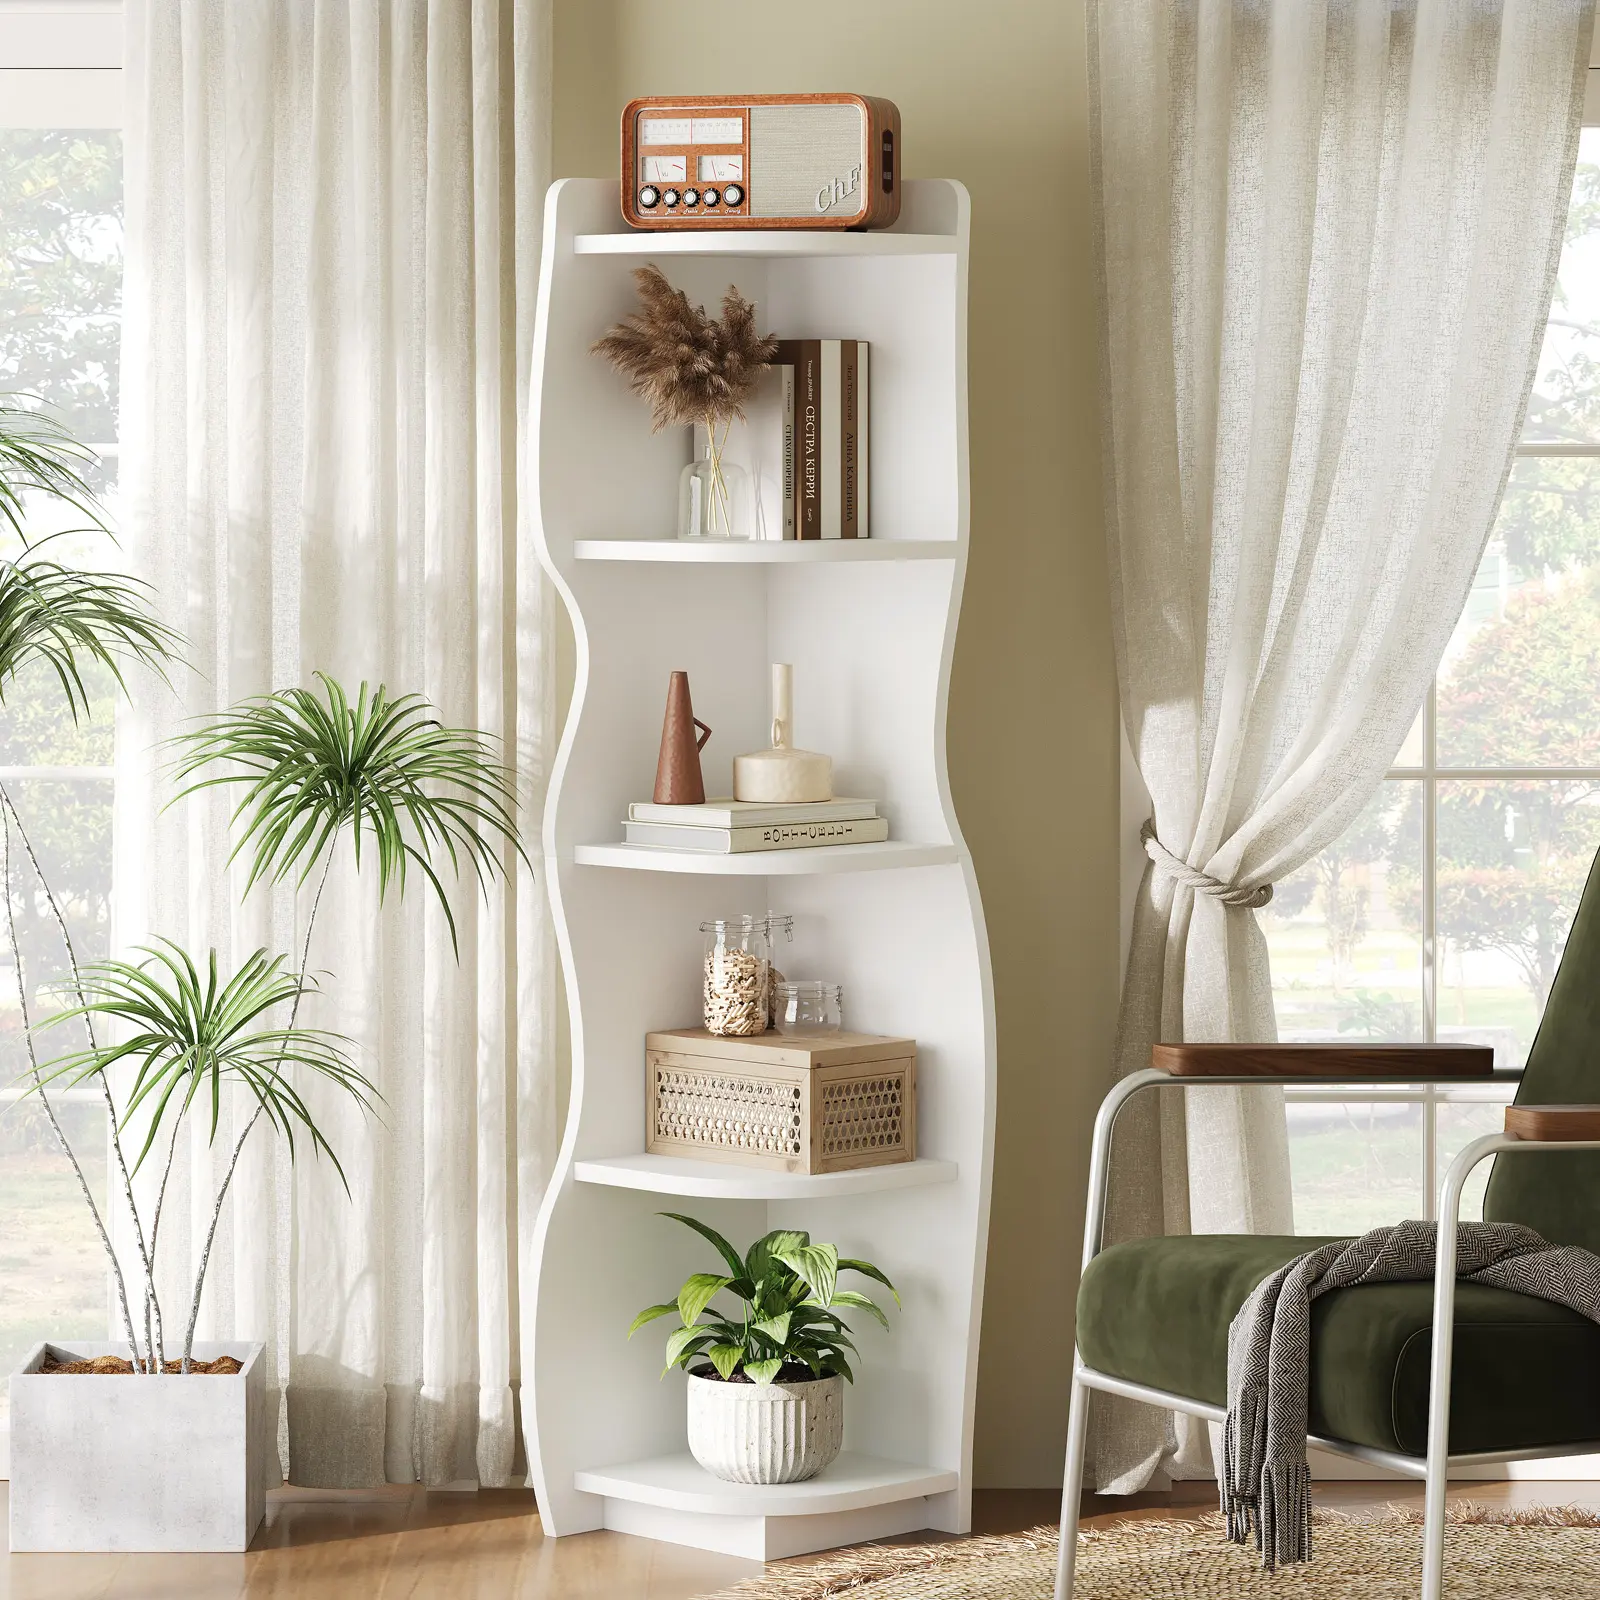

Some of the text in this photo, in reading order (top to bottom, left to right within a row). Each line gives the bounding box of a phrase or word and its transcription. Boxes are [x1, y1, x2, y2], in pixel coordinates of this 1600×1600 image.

[805, 405, 815, 499] СЕСТРА КЕРРИ
[764, 825, 853, 843] BOTTICELLI
